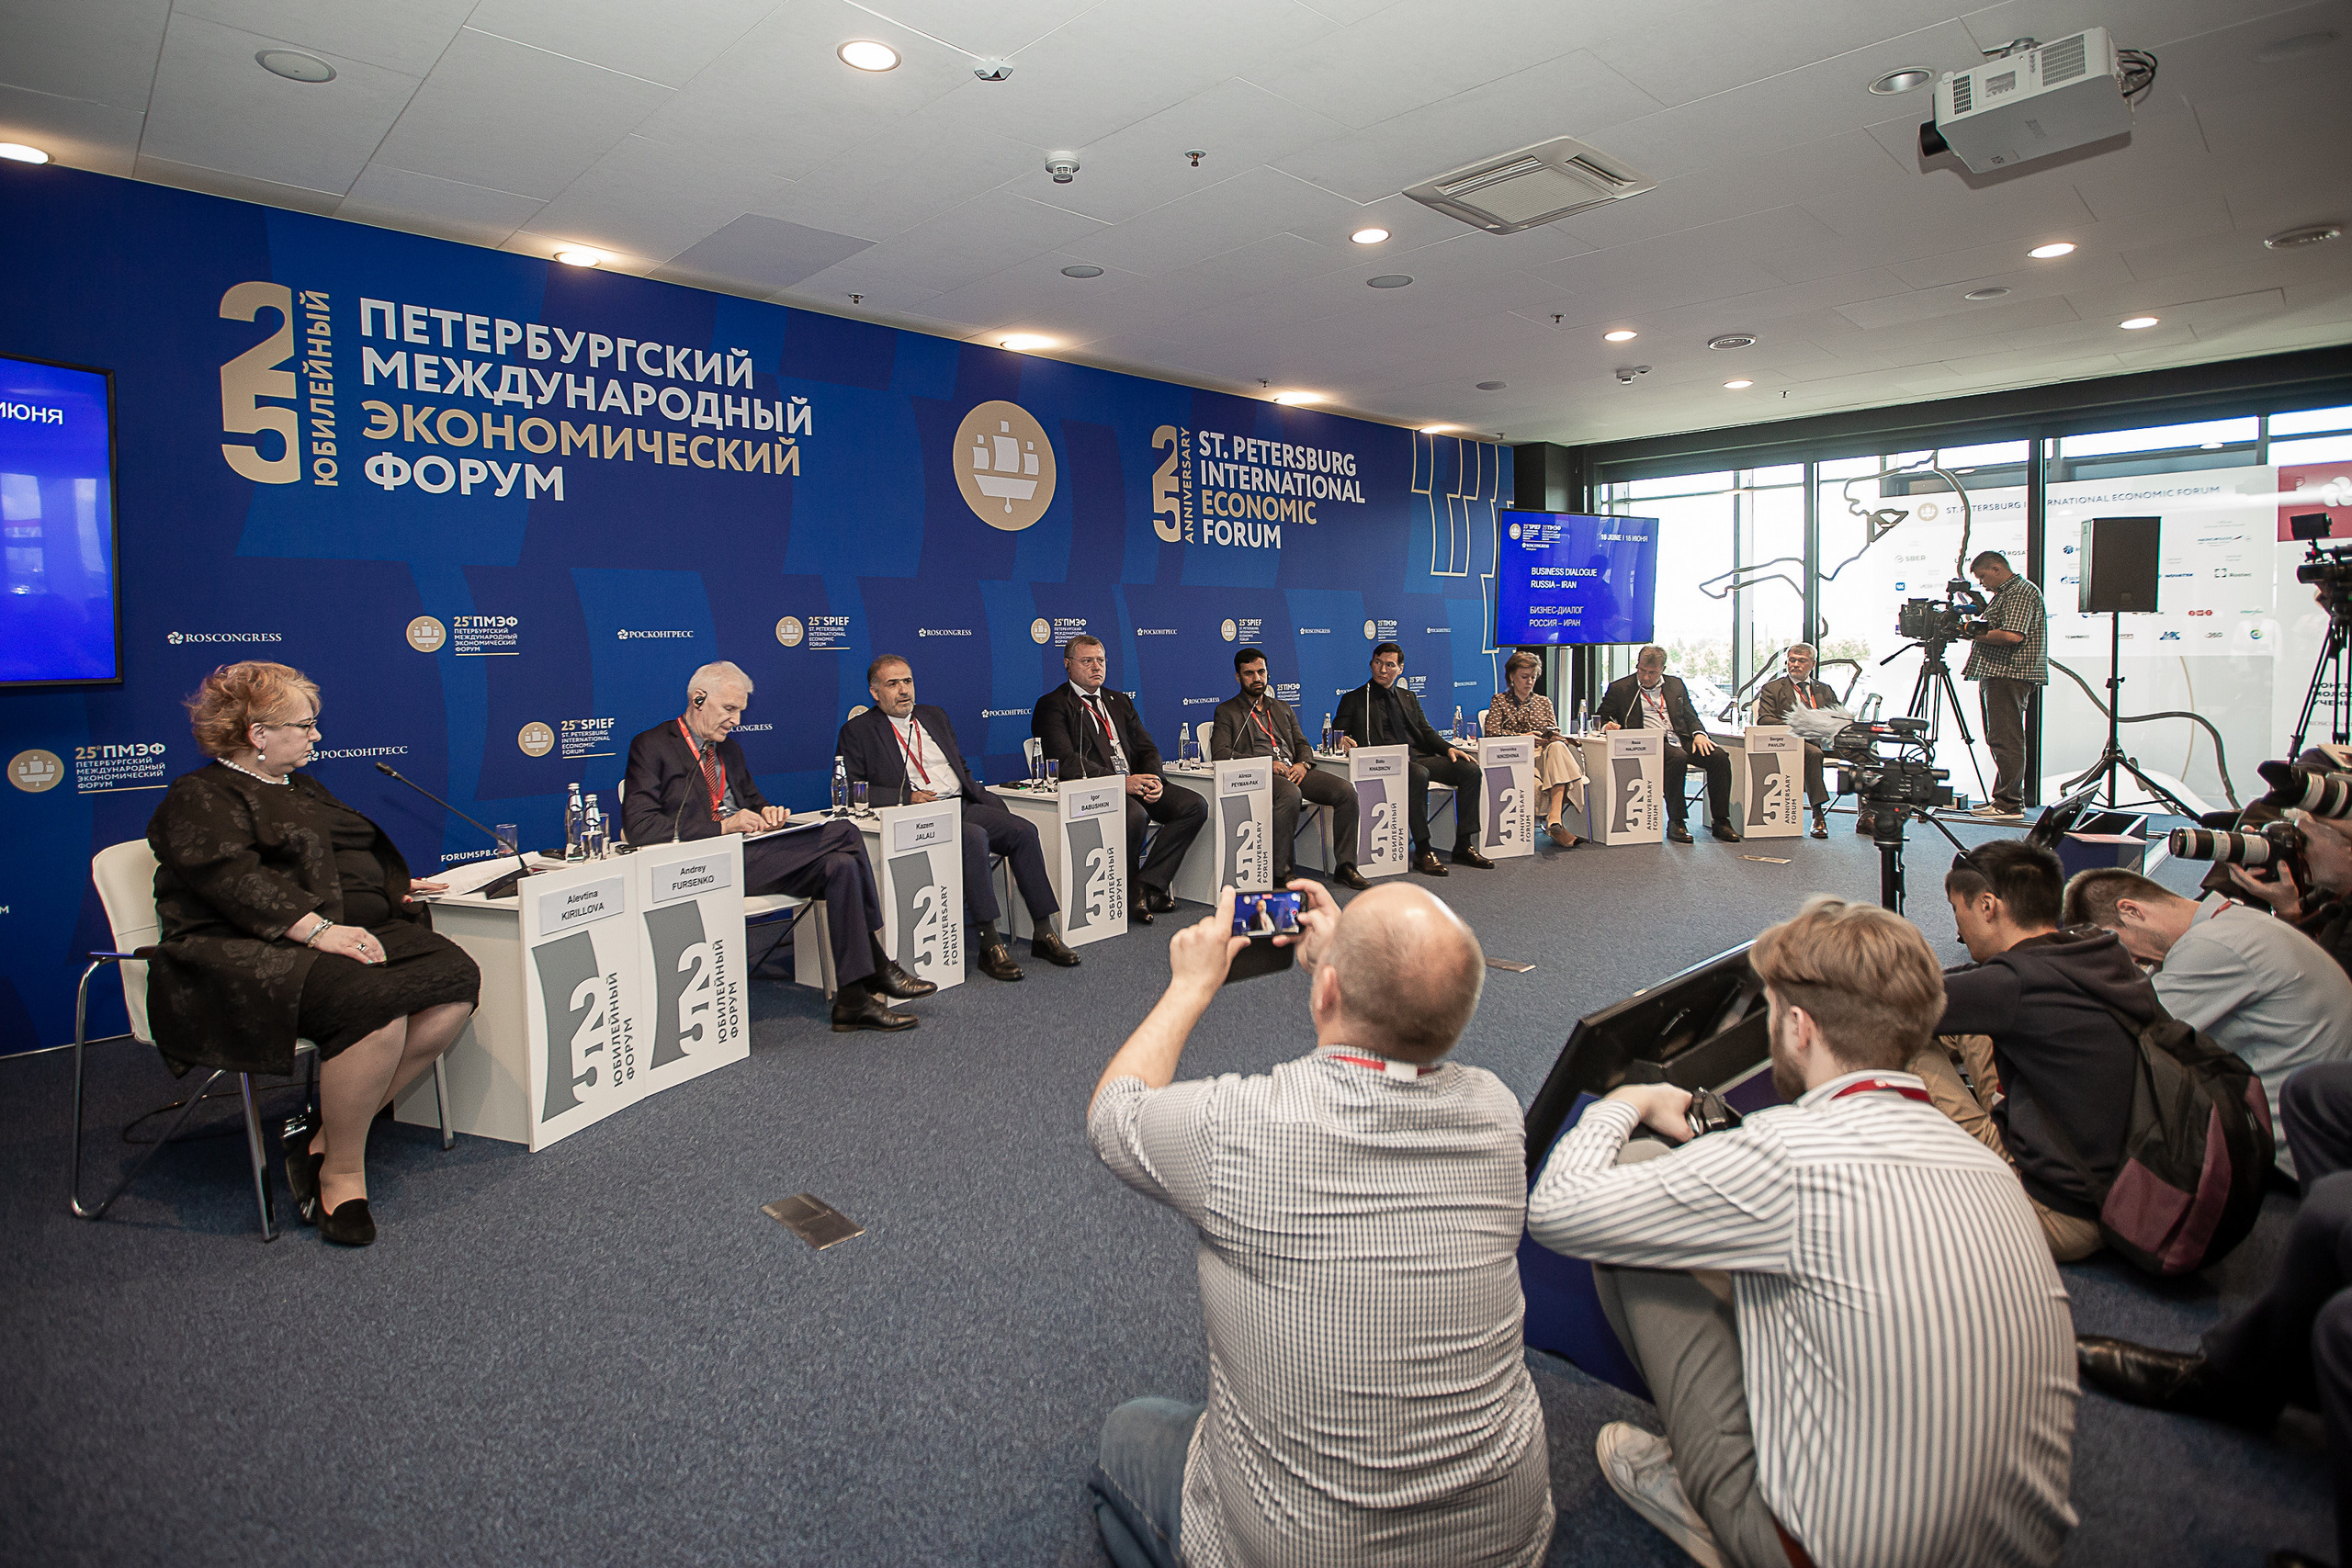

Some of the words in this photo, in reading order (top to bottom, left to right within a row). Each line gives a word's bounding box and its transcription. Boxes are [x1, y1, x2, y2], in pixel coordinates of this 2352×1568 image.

[360, 297, 754, 389] ПЕТЕРБУРГСКИЙ
[301, 290, 339, 487] ЮБИЛЕЙНЫЙ
[362, 346, 812, 436] МЕЖДУНАРОДНЫЙ
[362, 400, 801, 476] ЭКОНОМИЧЕСКИЙ
[1199, 431, 1227, 459] ST.
[1232, 434, 1357, 477] PETERSBURG
[365, 451, 565, 502] ФОРУМ
[1201, 461, 1365, 504] INTERNATIONAL
[1182, 426, 1194, 544] ANNIVERSARY
[1961, 502, 2021, 513] PTERSBURG
[2112, 490, 2174, 502] ECONOMIC
[2177, 485, 2221, 497] FORUM
[1202, 491, 1317, 525] ECONOMIC
[1203, 521, 1282, 549] FORUM
[1532, 567, 1564, 576] BUSINESS
[1566, 568, 1597, 576] DIALOGUE
[1531, 581, 1555, 589] RUSSIA
[1530, 606, 1584, 615] БИЗНЕС-ДИАЛОГ
[473, 616, 518, 627] ПМЭФ
[824, 616, 849, 626] SPIEF
[186, 633, 282, 643] ROSCONGRESS
[989, 708, 1032, 716] РОСКОНГРЕСС
[581, 718, 615, 729] SPIEF
[729, 724, 773, 733] CONGRESS
[103, 743, 166, 758] ПМЭФ
[321, 745, 408, 759] РОСКОНГРЕСС
[76, 757, 153, 768] ПЕТЕРБУРГСКИЙ
[76, 763, 166, 775] МЕЖДУНАРОДНЫЙ
[77, 770, 164, 782] ЭКОНОМИЧЕСКИЙ
[1081, 802, 1109, 811] BABUSHKIN
[915, 832, 935, 841] JALALI
[680, 864, 707, 876] Andrey
[672, 875, 715, 891] FURSENKO
[1107, 847, 1115, 921] ЮБИЛЕЙНЫЙ
[567, 890, 598, 905] Alevtina
[561, 902, 604, 921] KIRILLOVA
[941, 886, 949, 966] ANNIVERSARY
[713, 939, 727, 1044] ЮБИЛЕЙНЫЙ
[729, 981, 738, 1038] ФОРУМ
[606, 971, 623, 1088] ЮБИЛЕЙНЫЙ
[624, 1017, 635, 1080] ФОРУМ
